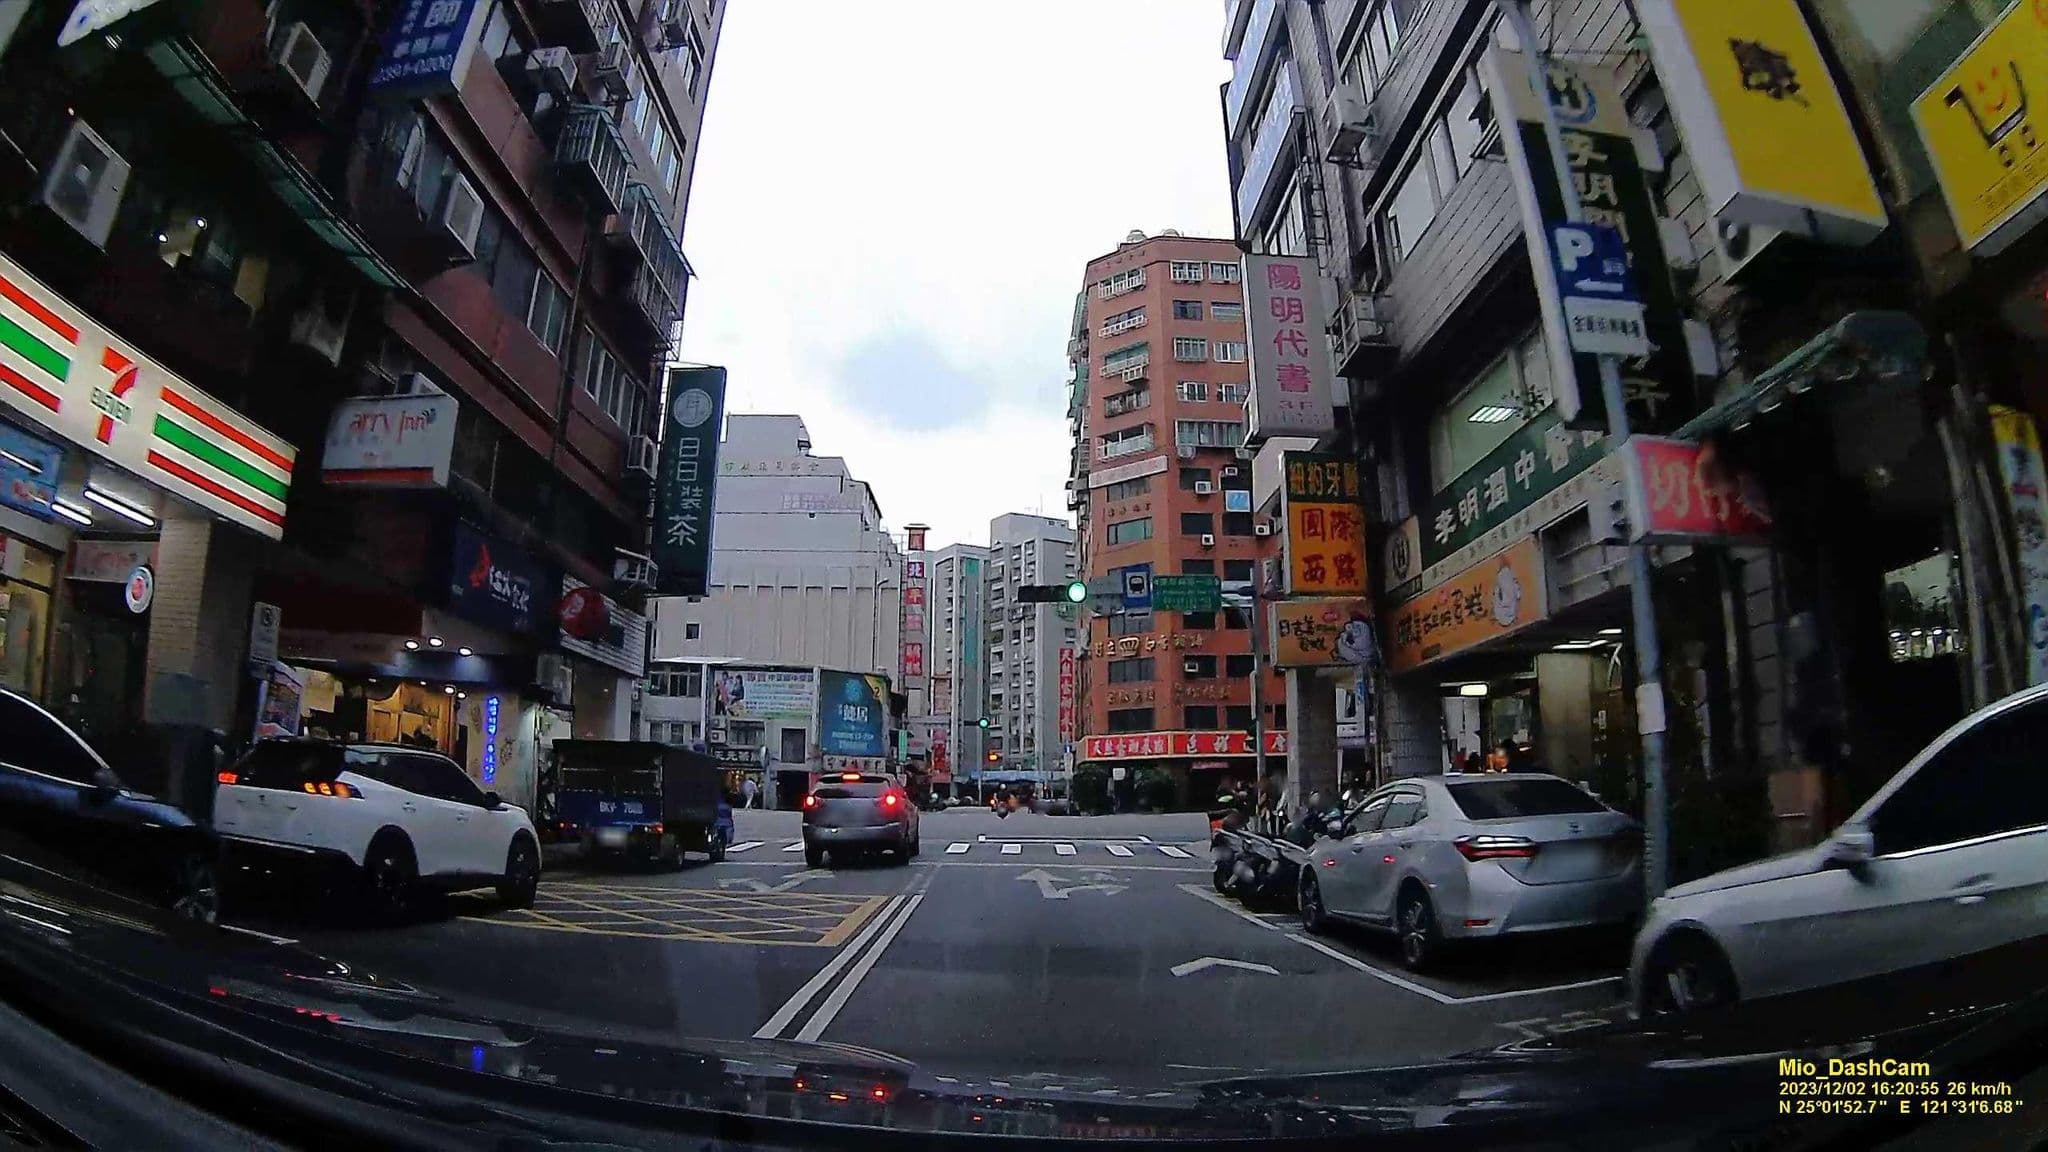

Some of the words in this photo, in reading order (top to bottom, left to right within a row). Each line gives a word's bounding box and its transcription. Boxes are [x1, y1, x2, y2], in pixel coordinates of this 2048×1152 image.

[1553, 227, 1594, 271] P
[1267, 263, 1313, 393] 陽明代書
[95, 345, 139, 445] 7
[667, 437, 704, 546] 日日裝茶
